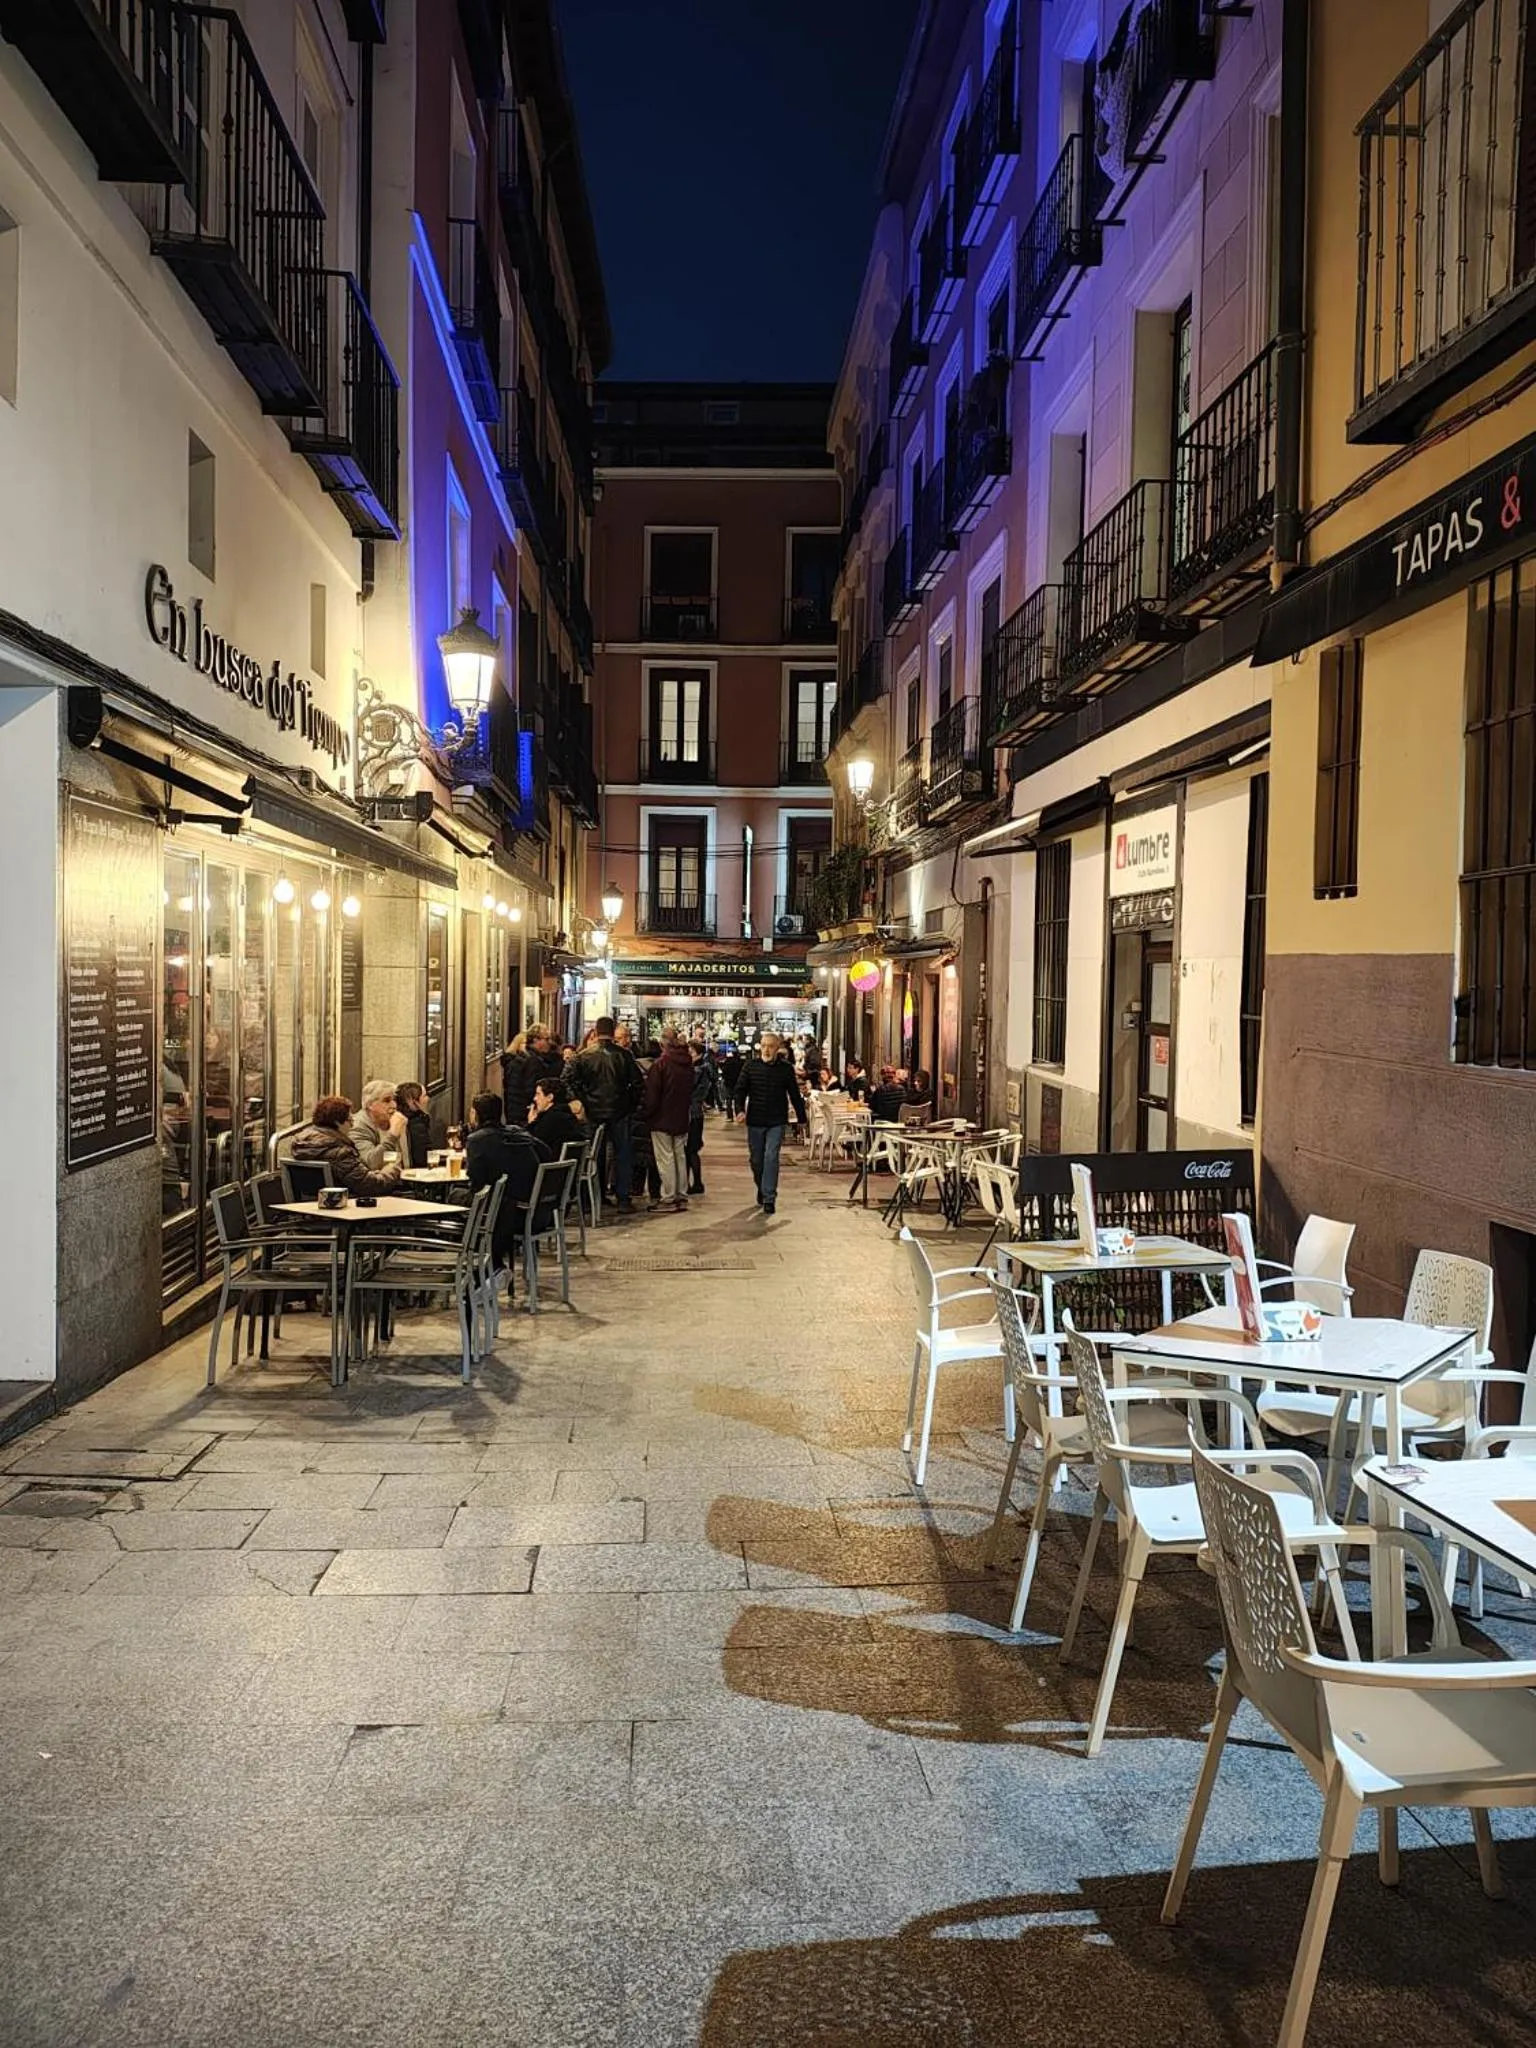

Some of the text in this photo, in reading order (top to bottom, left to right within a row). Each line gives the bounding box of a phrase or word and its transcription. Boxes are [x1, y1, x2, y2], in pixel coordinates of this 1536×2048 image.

[1392, 475, 1522, 587] TAPAS &
[145, 563, 187, 663] En
[194, 598, 264, 708] busca
[265, 660, 296, 732] del
[668, 963, 756, 973] MAJADERITOS
